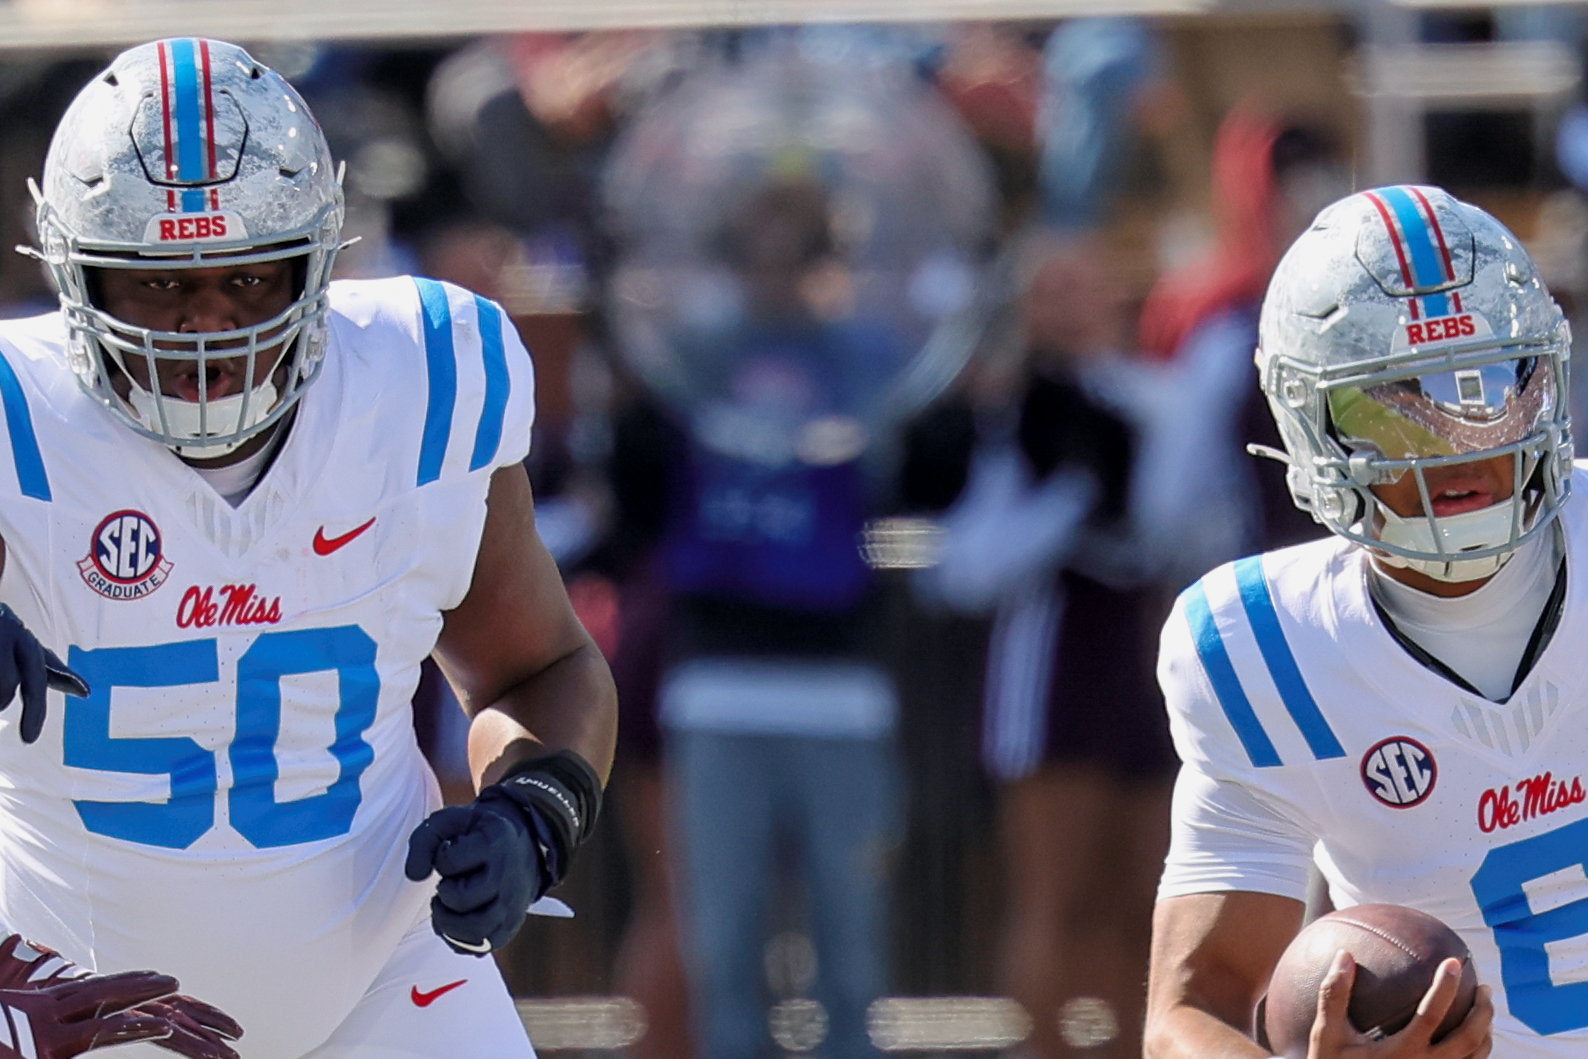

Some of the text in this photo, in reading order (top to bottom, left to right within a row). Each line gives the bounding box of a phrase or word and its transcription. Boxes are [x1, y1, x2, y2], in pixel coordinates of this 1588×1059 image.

[160, 215, 226, 240] REBS
[1406, 314, 1475, 346] REBS
[99, 515, 157, 578] SEC
[87, 571, 160, 598] GRADUATE
[176, 583, 283, 629] Ole Miss
[63, 624, 381, 850] 50
[1366, 741, 1432, 804] SEC
[1478, 771, 1586, 833] Ole Miss
